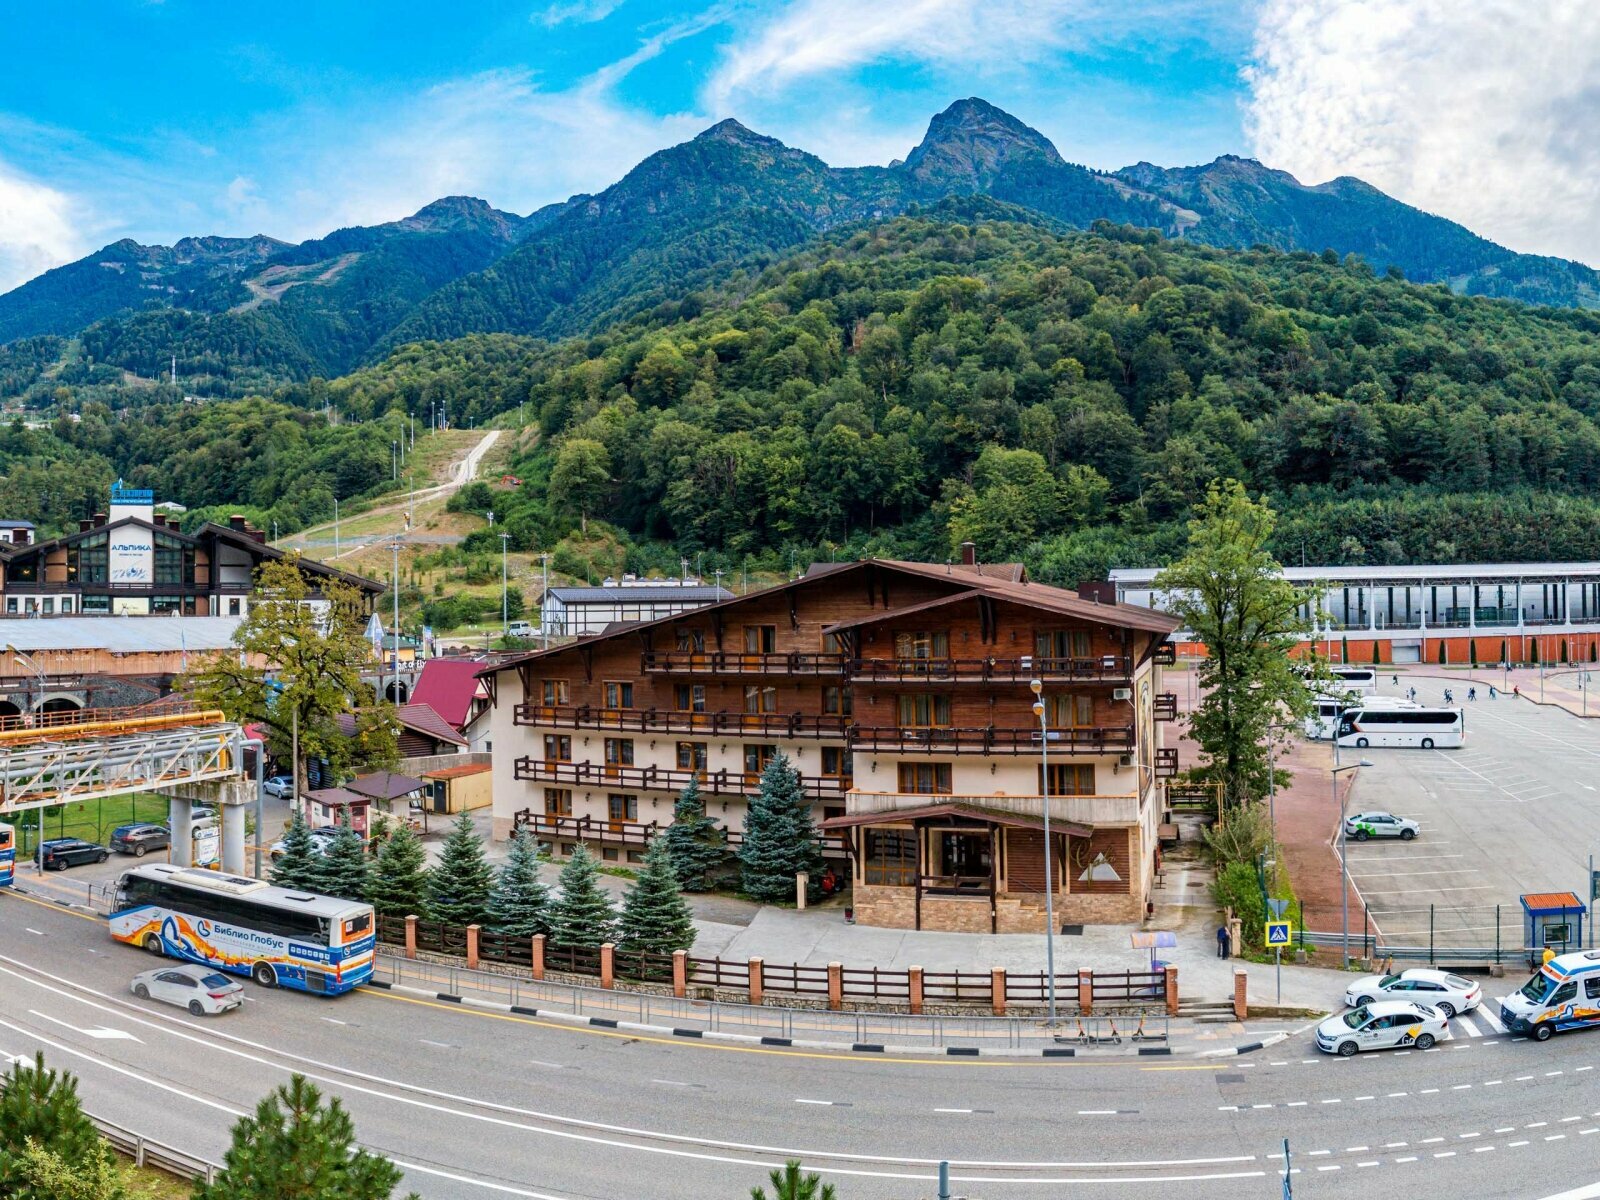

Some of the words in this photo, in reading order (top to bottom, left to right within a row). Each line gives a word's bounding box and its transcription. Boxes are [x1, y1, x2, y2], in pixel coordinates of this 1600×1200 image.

[214, 924, 249, 940] Библио
[250, 933, 284, 949] Глобус
[1401, 1035, 1415, 1046] Go
